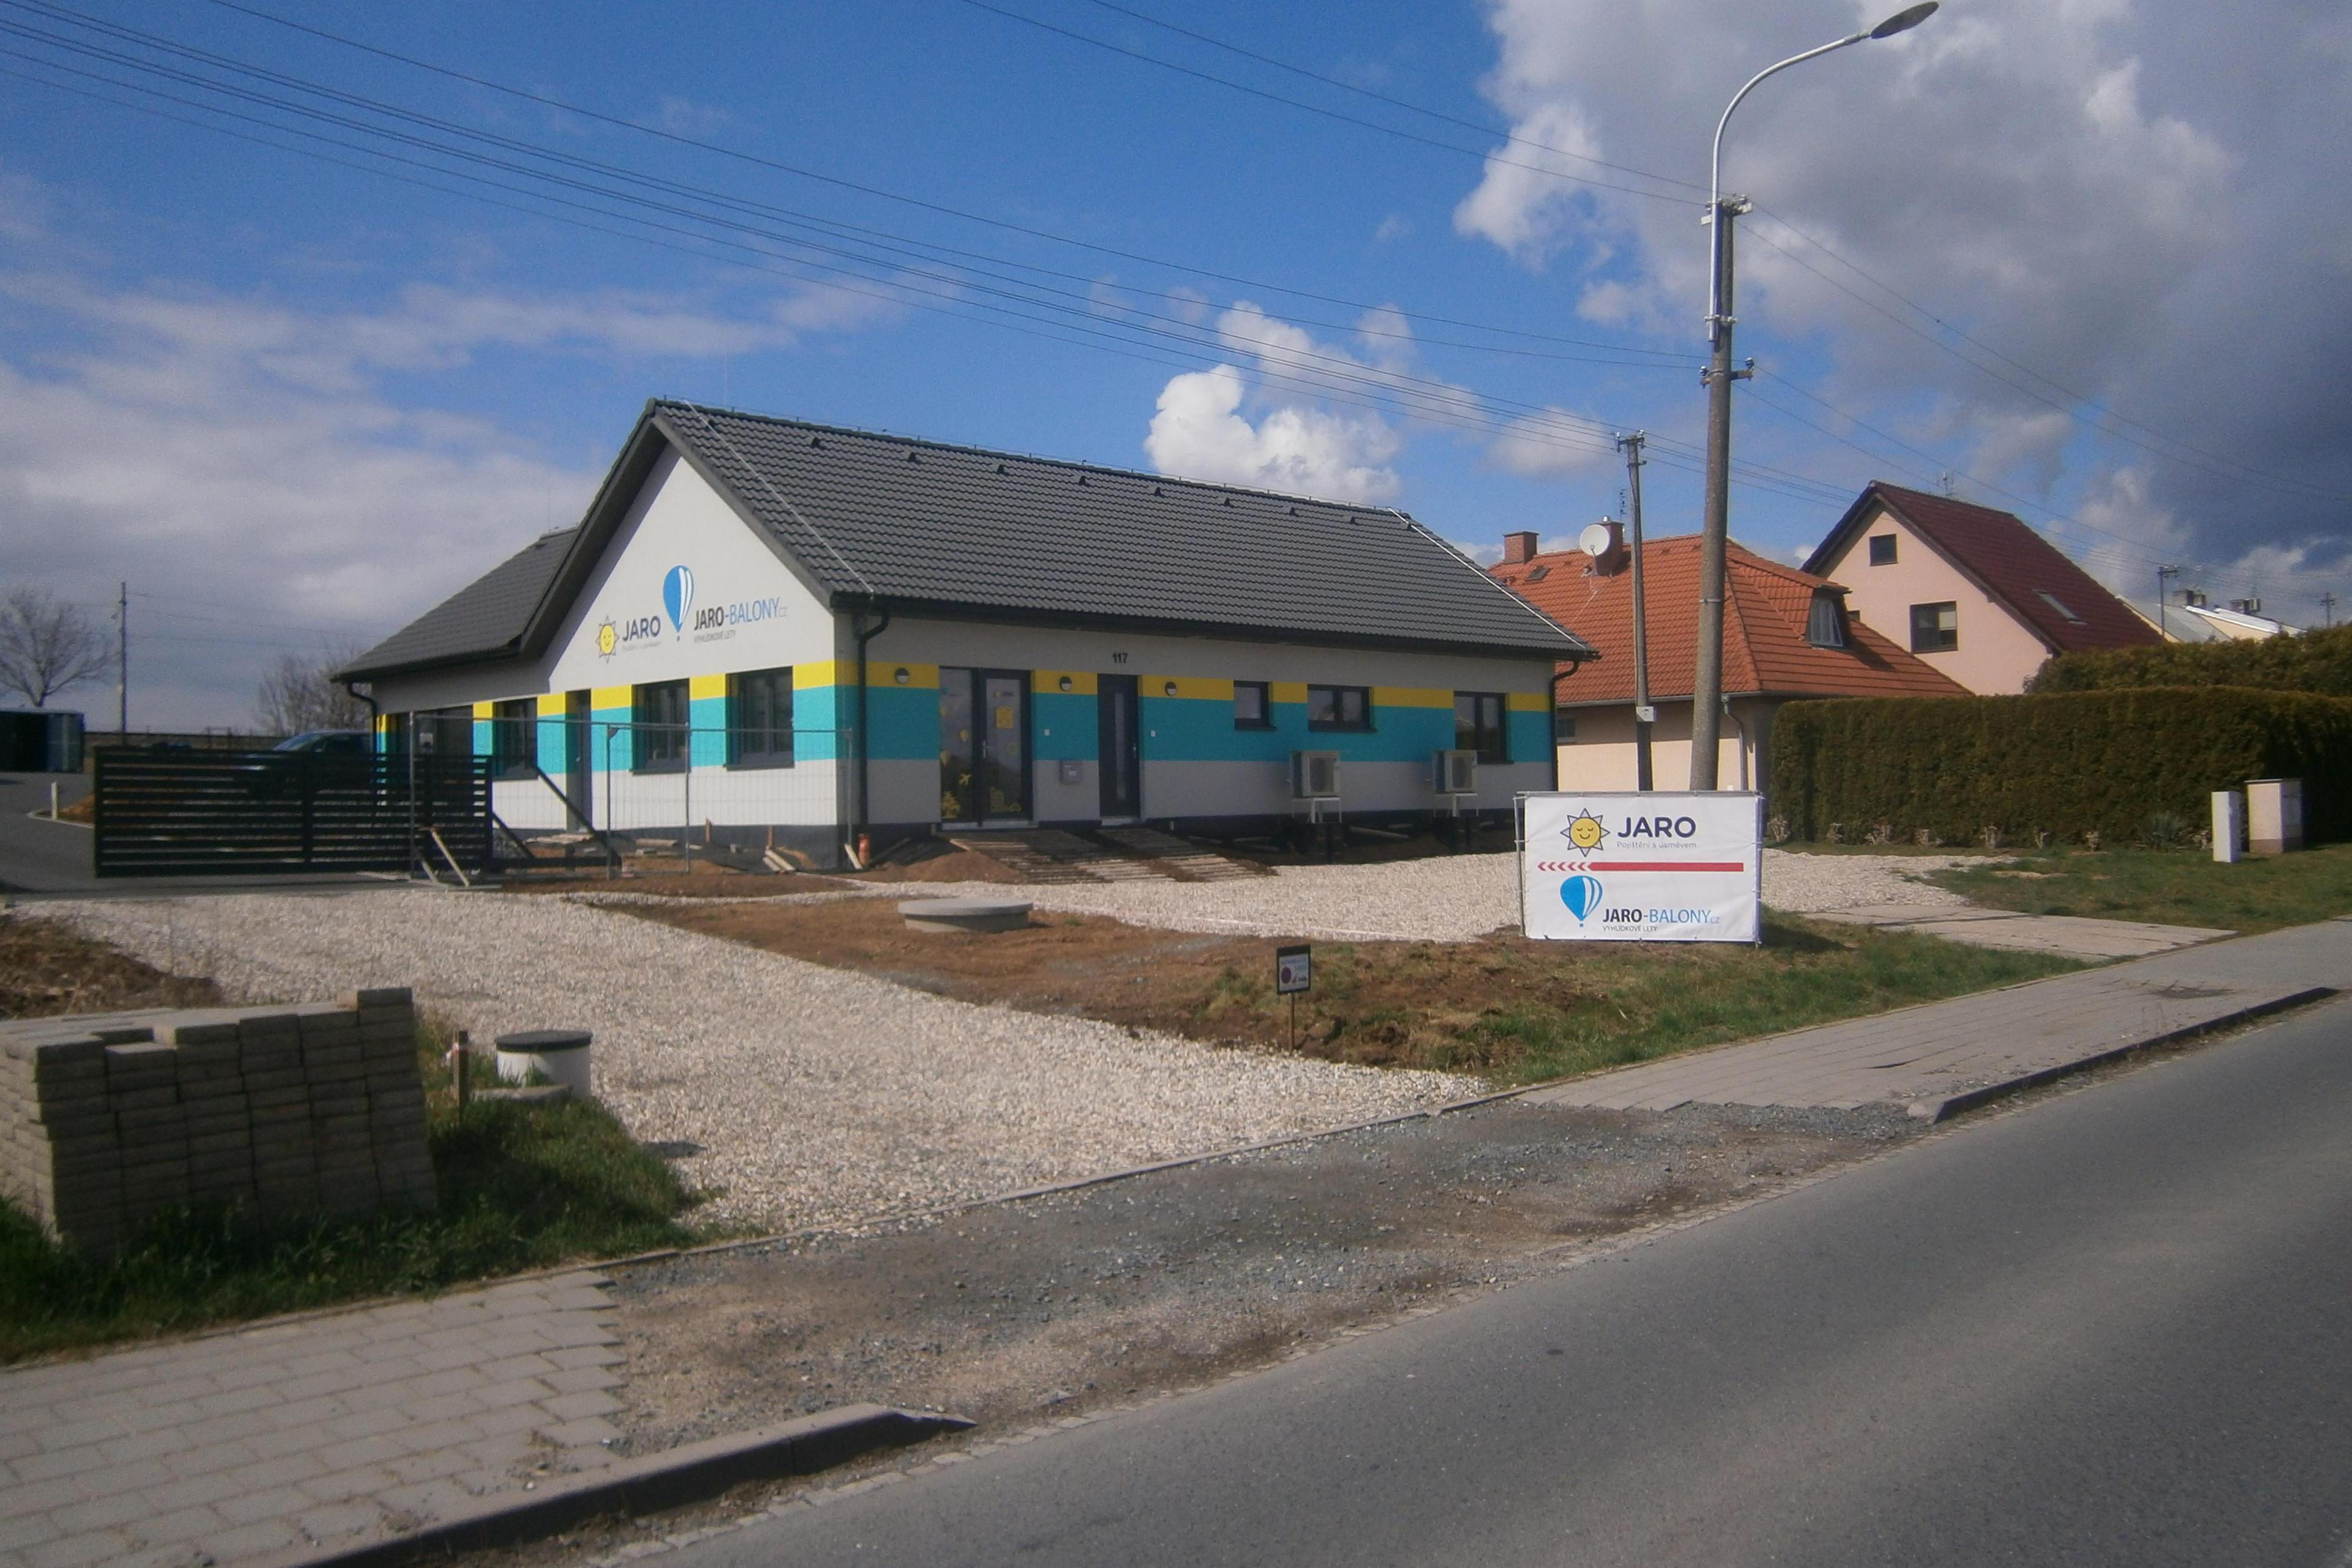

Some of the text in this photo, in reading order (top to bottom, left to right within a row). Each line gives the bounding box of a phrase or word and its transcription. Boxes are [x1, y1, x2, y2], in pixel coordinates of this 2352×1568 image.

[694, 597, 779, 631] JARO-BALONY
[622, 615, 661, 642] JARO
[1112, 652, 1128, 663] 117
[1618, 816, 1697, 838] JARO
